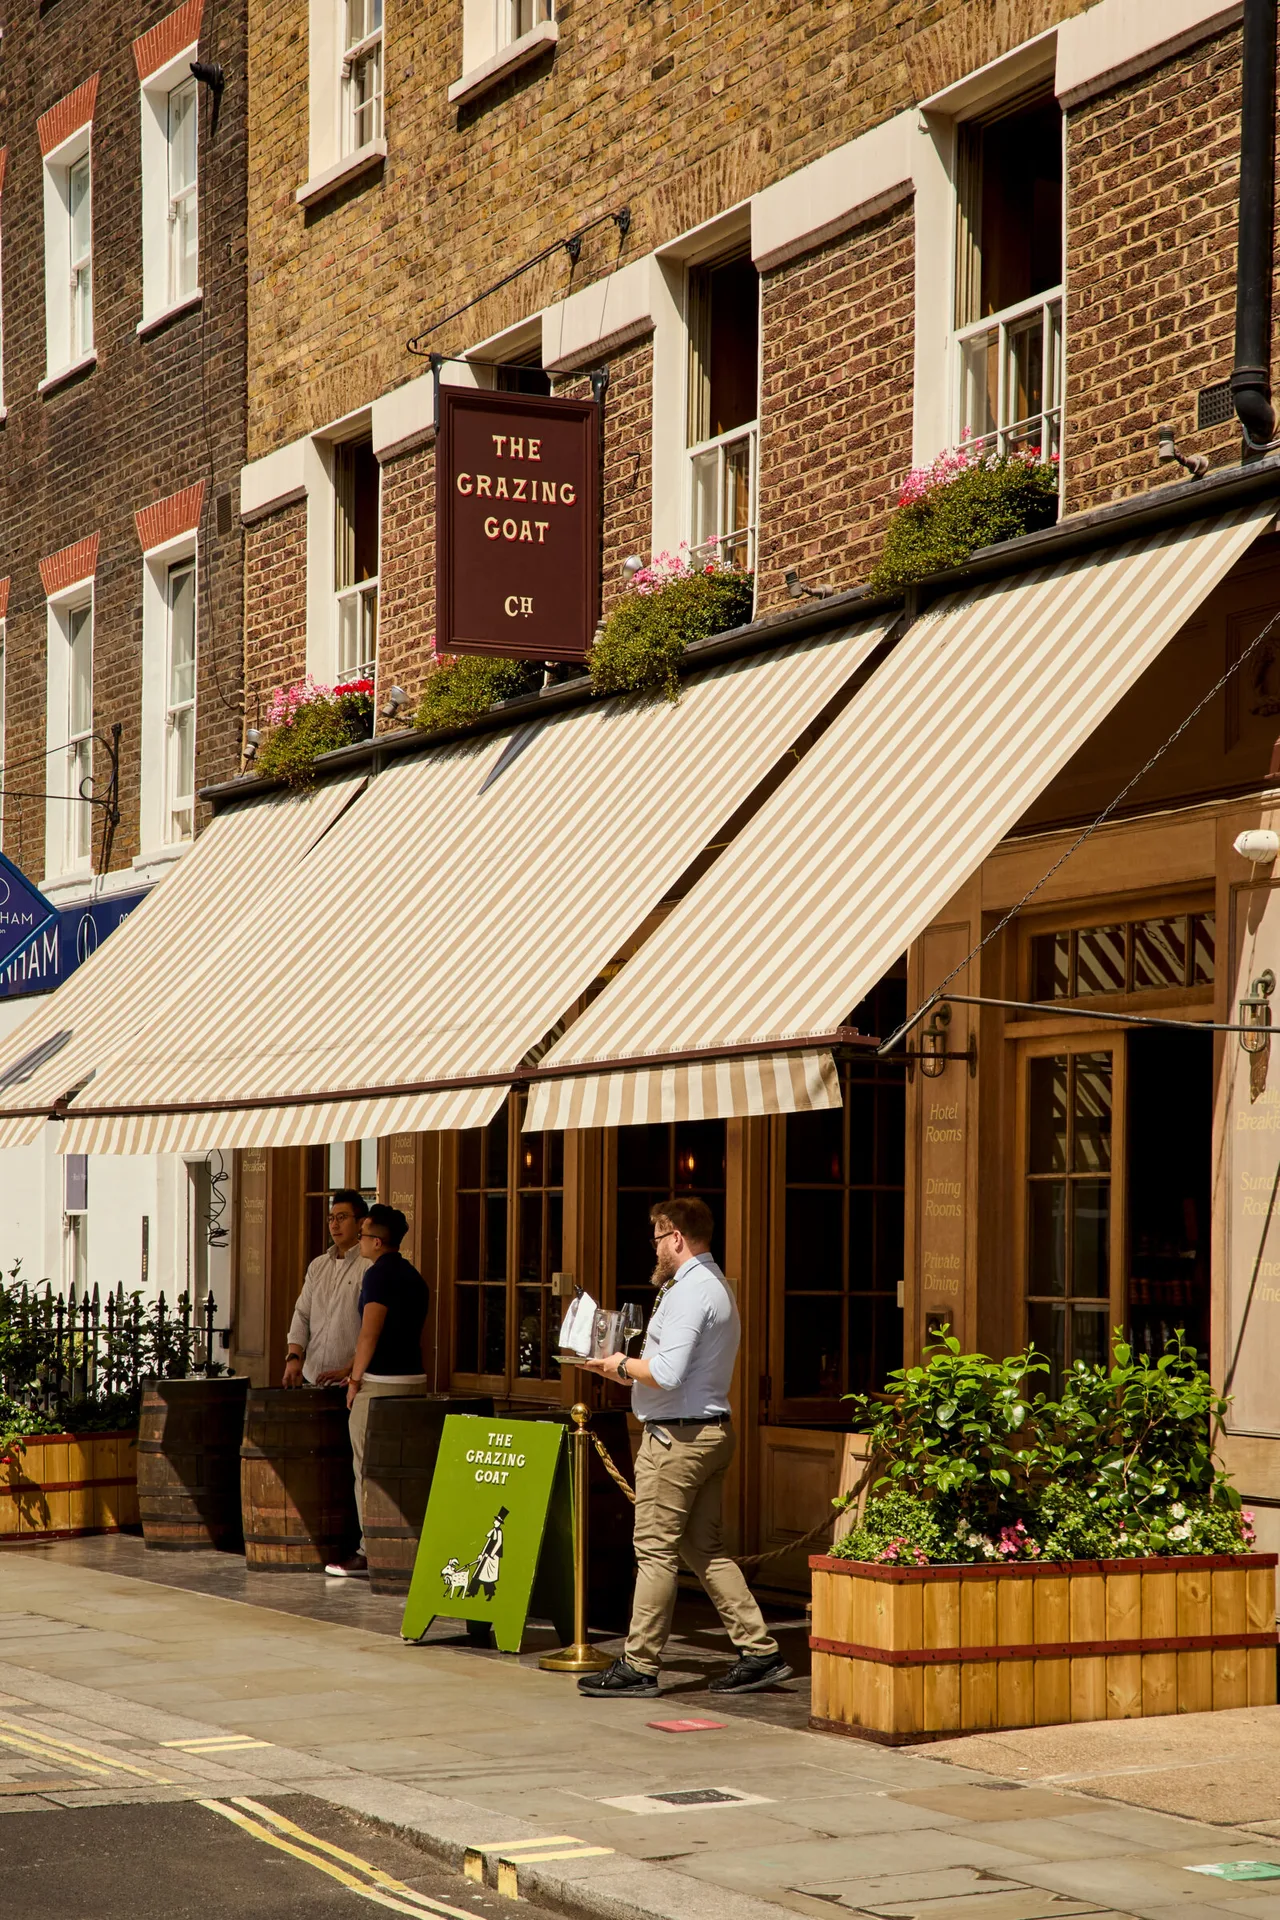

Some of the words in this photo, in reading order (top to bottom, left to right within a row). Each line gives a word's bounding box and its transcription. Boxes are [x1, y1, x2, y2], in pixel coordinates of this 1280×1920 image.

[492, 434, 542, 461] THE
[457, 472, 577, 506] GRAZING
[484, 516, 549, 544] GOAT
[930, 1103, 958, 1120] Hotel
[394, 1135, 412, 1149] Hotel
[925, 1126, 963, 1142] Rooms
[391, 1152, 415, 1165] Rooms
[926, 1178, 962, 1198] Dining
[392, 1191, 414, 1207] Dining
[925, 1200, 962, 1217] Rooms
[923, 1251, 961, 1269] Private
[924, 1274, 959, 1295] Dining
[488, 1432, 513, 1448] THE
[466, 1450, 526, 1468] GRAZING
[475, 1469, 510, 1485] GOAT
